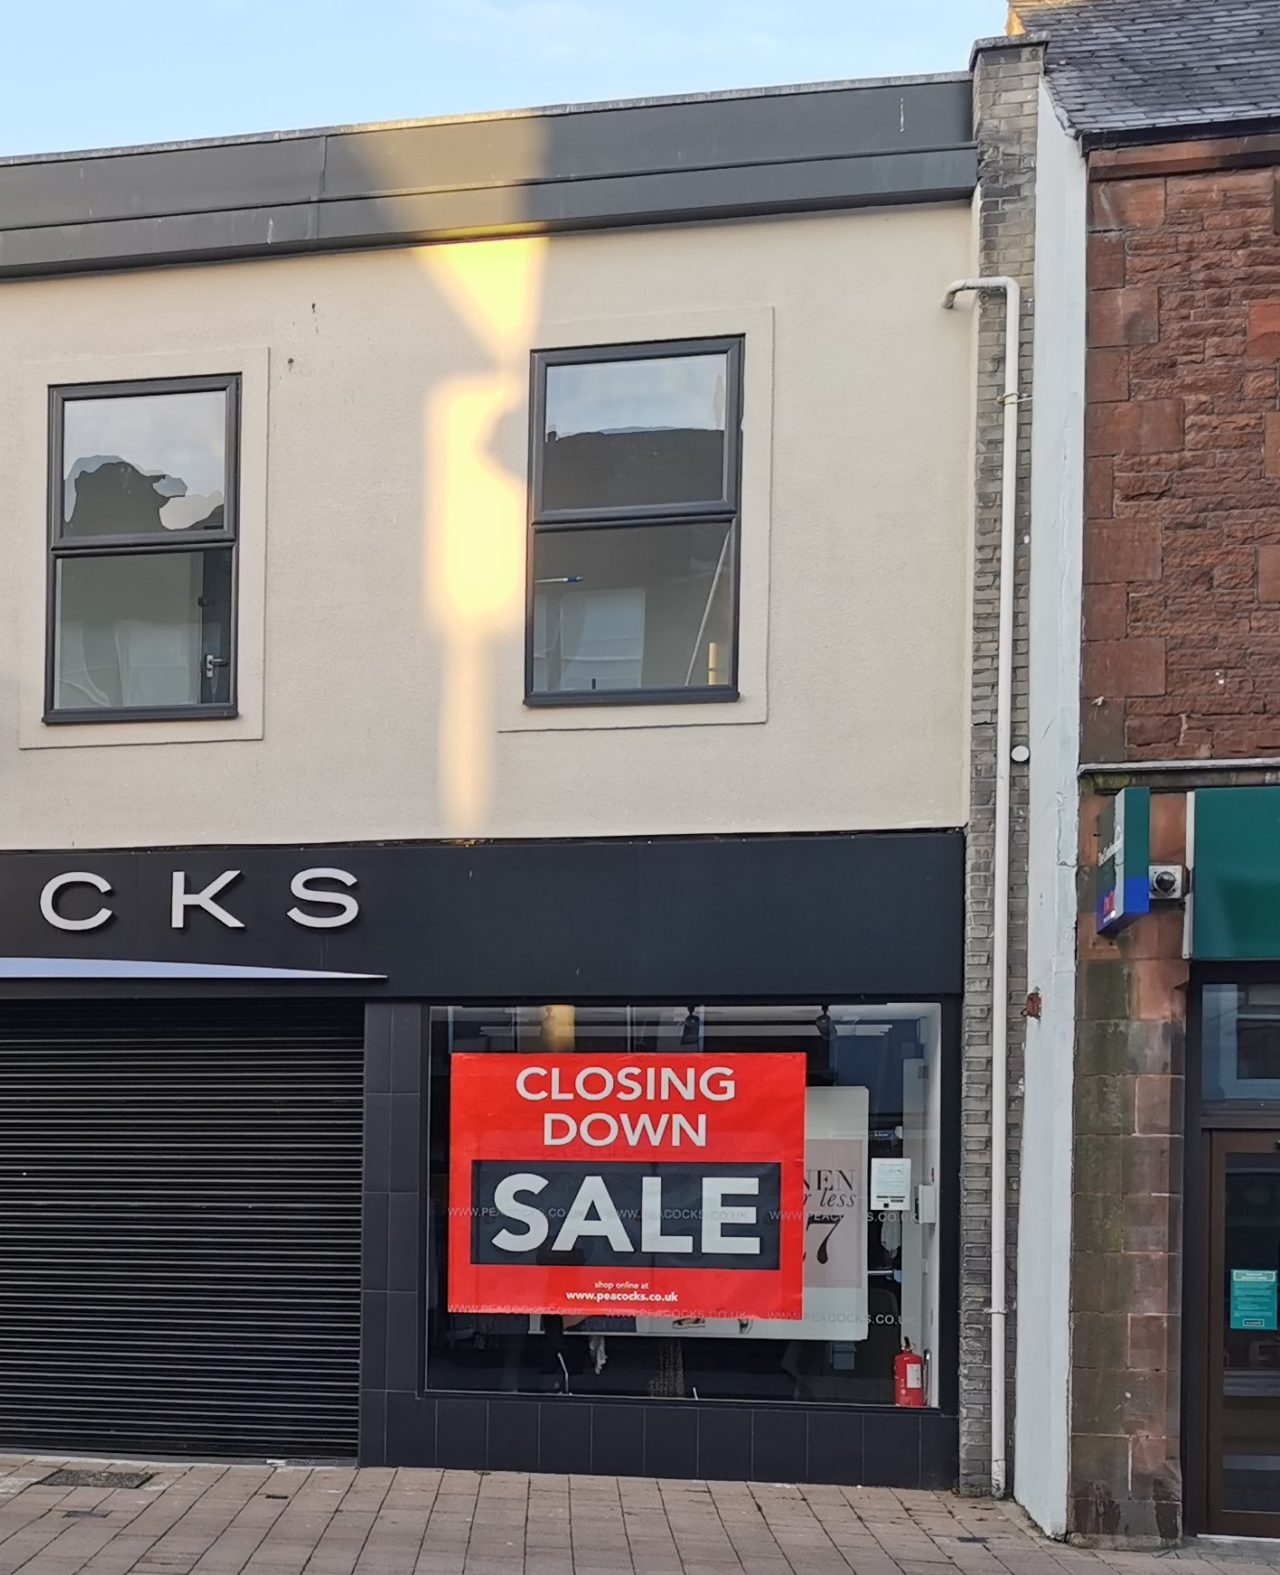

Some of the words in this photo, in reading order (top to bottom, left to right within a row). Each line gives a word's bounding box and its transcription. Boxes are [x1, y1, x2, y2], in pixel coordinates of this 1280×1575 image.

[515, 1066, 736, 1102] CLOSING
[542, 1113, 708, 1147] DOWN
[820, 1187, 857, 1208] less
[491, 1172, 762, 1256] SALE
[565, 1290, 679, 1303] www.peacocks.co.uk
[594, 1280, 614, 1290] shop
[615, 1281, 639, 1290] online
[640, 1281, 649, 1290] at
